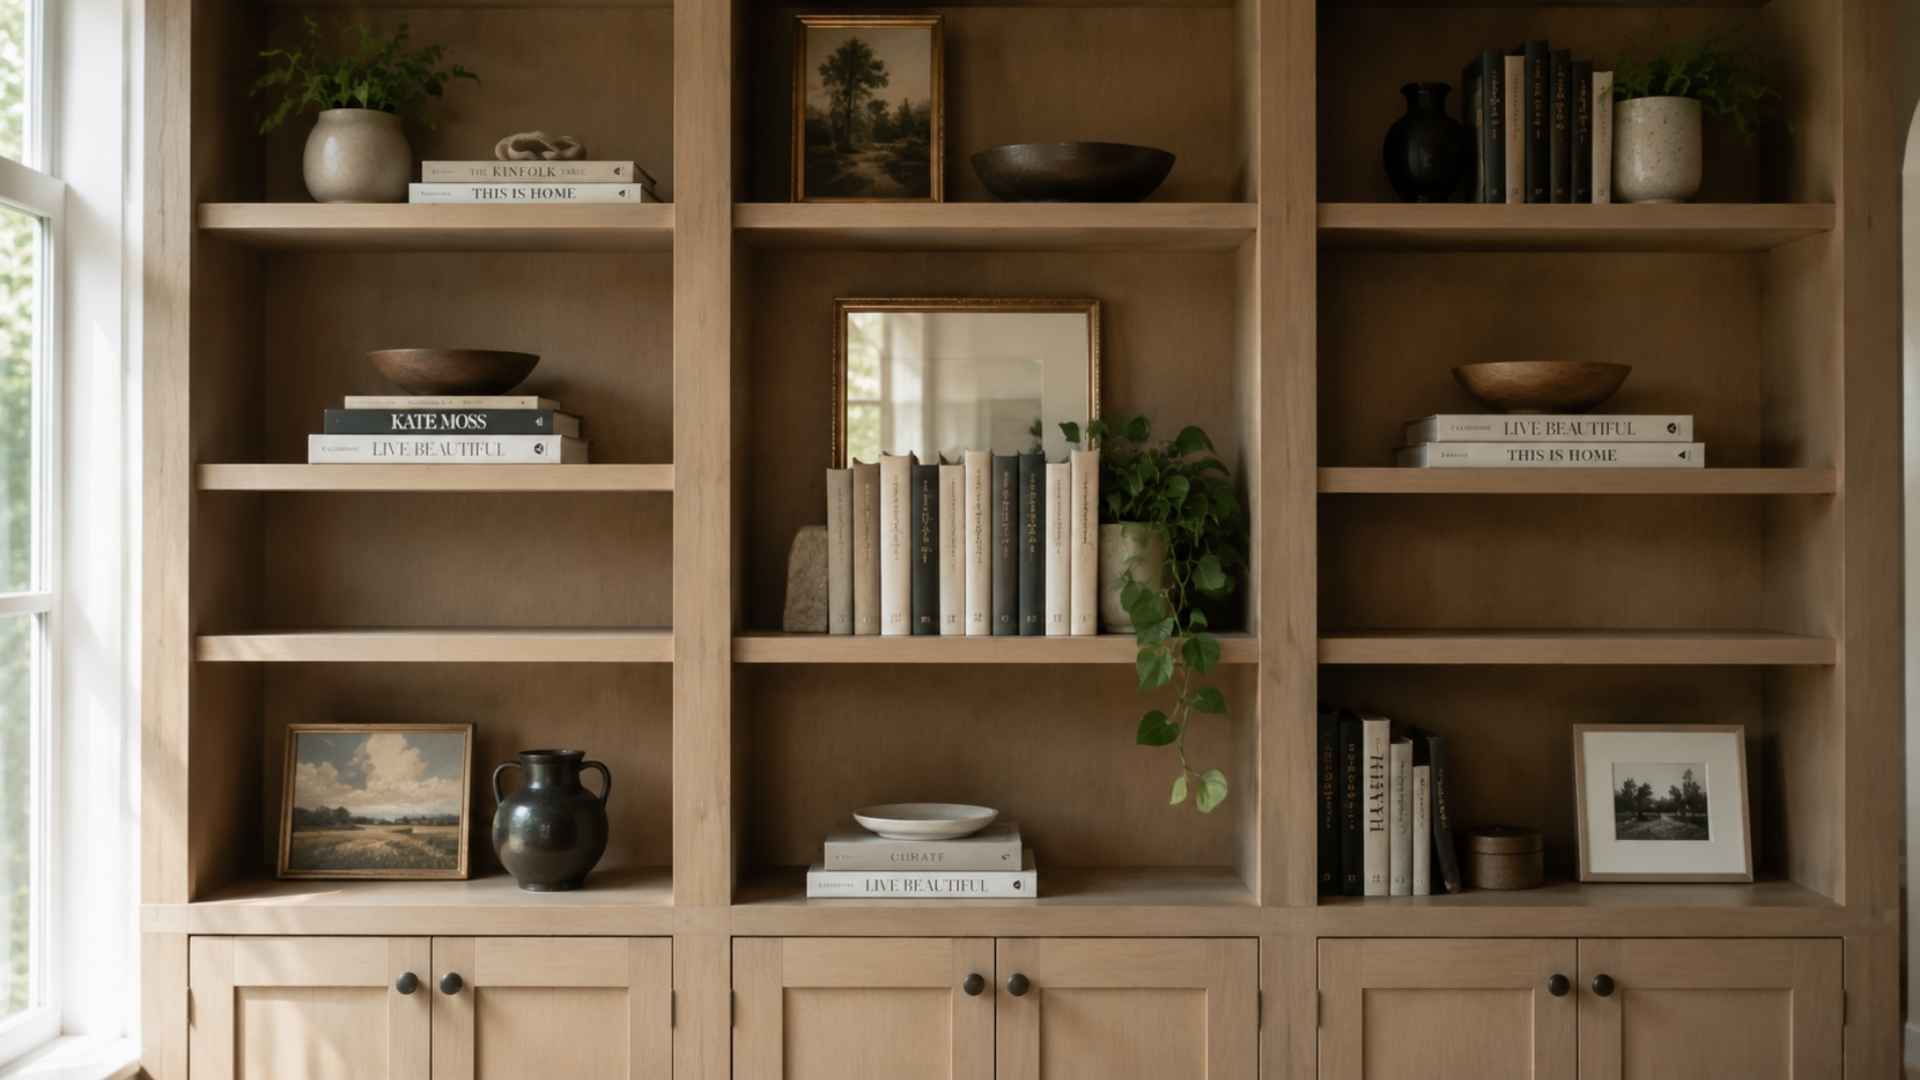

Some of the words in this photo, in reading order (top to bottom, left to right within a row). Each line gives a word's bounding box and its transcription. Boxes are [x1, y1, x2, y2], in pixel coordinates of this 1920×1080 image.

[493, 166, 556, 177] KINFOLK
[472, 187, 508, 199] THIS
[512, 187, 526, 199] IS
[531, 187, 577, 199] HOME
[391, 414, 437, 430] KATE
[440, 414, 487, 430] MOSS
[1504, 421, 1541, 436] LIVE
[1545, 421, 1636, 436] BEAUTIFUL
[372, 441, 410, 456] LIVE
[415, 441, 505, 456] BEAUTIFUL
[1507, 449, 1545, 462] THIS
[1549, 449, 1564, 462] IS
[1568, 449, 1617, 462] HOME
[865, 879, 899, 893] LIVE
[903, 879, 989, 893] BEAUTIFUL
